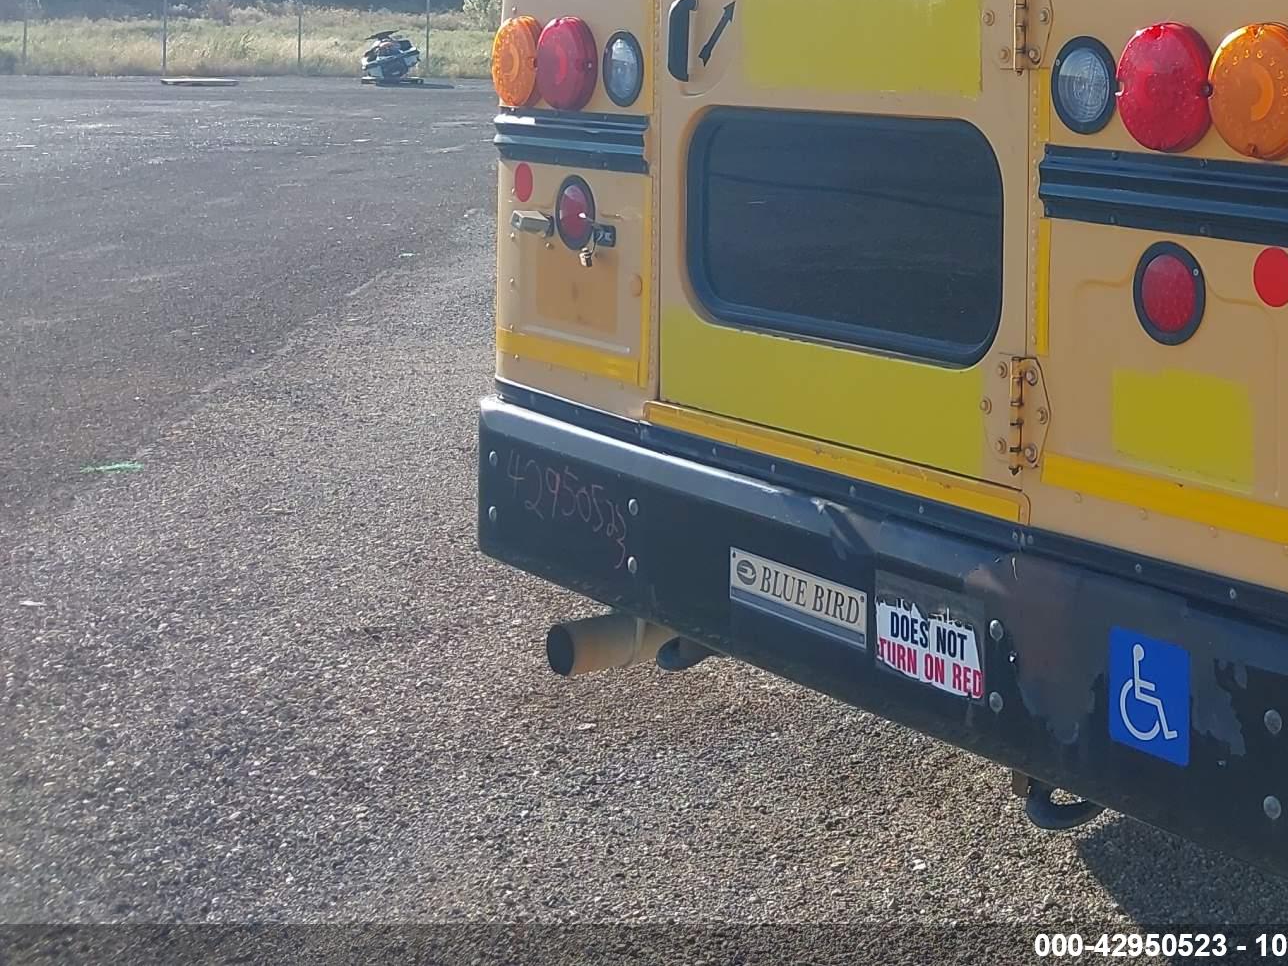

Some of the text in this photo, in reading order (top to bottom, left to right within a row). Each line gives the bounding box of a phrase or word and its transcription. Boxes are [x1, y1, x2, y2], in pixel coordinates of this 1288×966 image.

[760, 565, 808, 608] BLUE
[812, 583, 861, 625] BIRD
[890, 611, 929, 649] DOES
[935, 625, 968, 662] NOT
[879, 637, 984, 699] TURN ON RED
